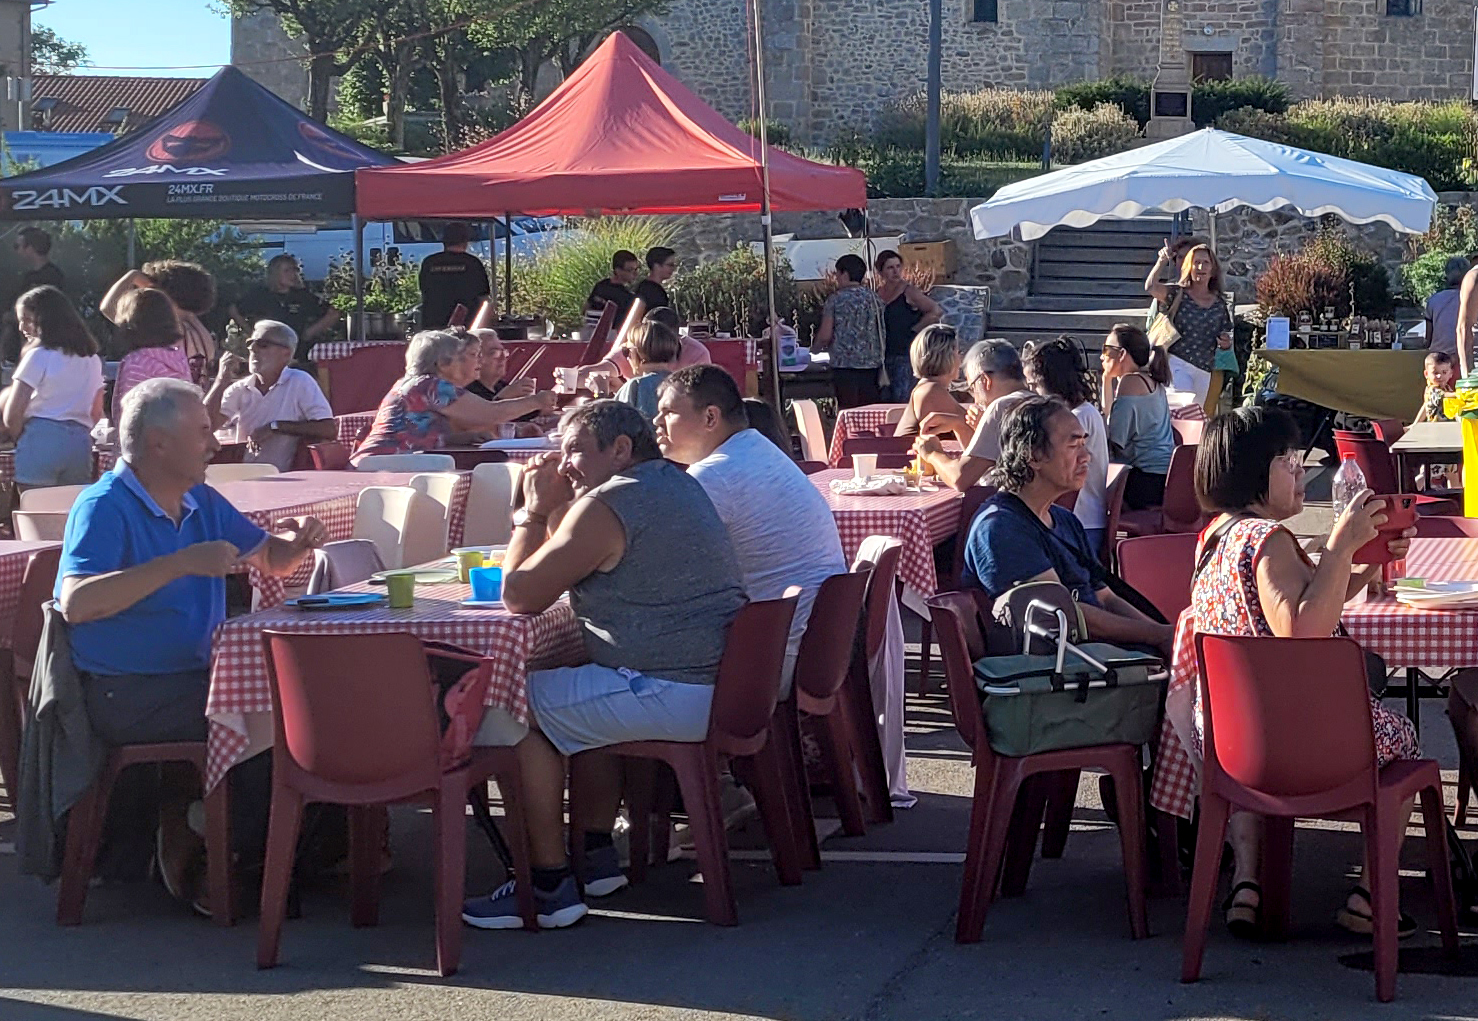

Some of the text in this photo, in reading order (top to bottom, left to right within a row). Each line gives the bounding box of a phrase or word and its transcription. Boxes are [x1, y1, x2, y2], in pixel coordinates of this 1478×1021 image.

[102, 164, 230, 178] 24MX
[167, 183, 214, 195] 24MX.FR
[12, 185, 128, 210] 24MX
